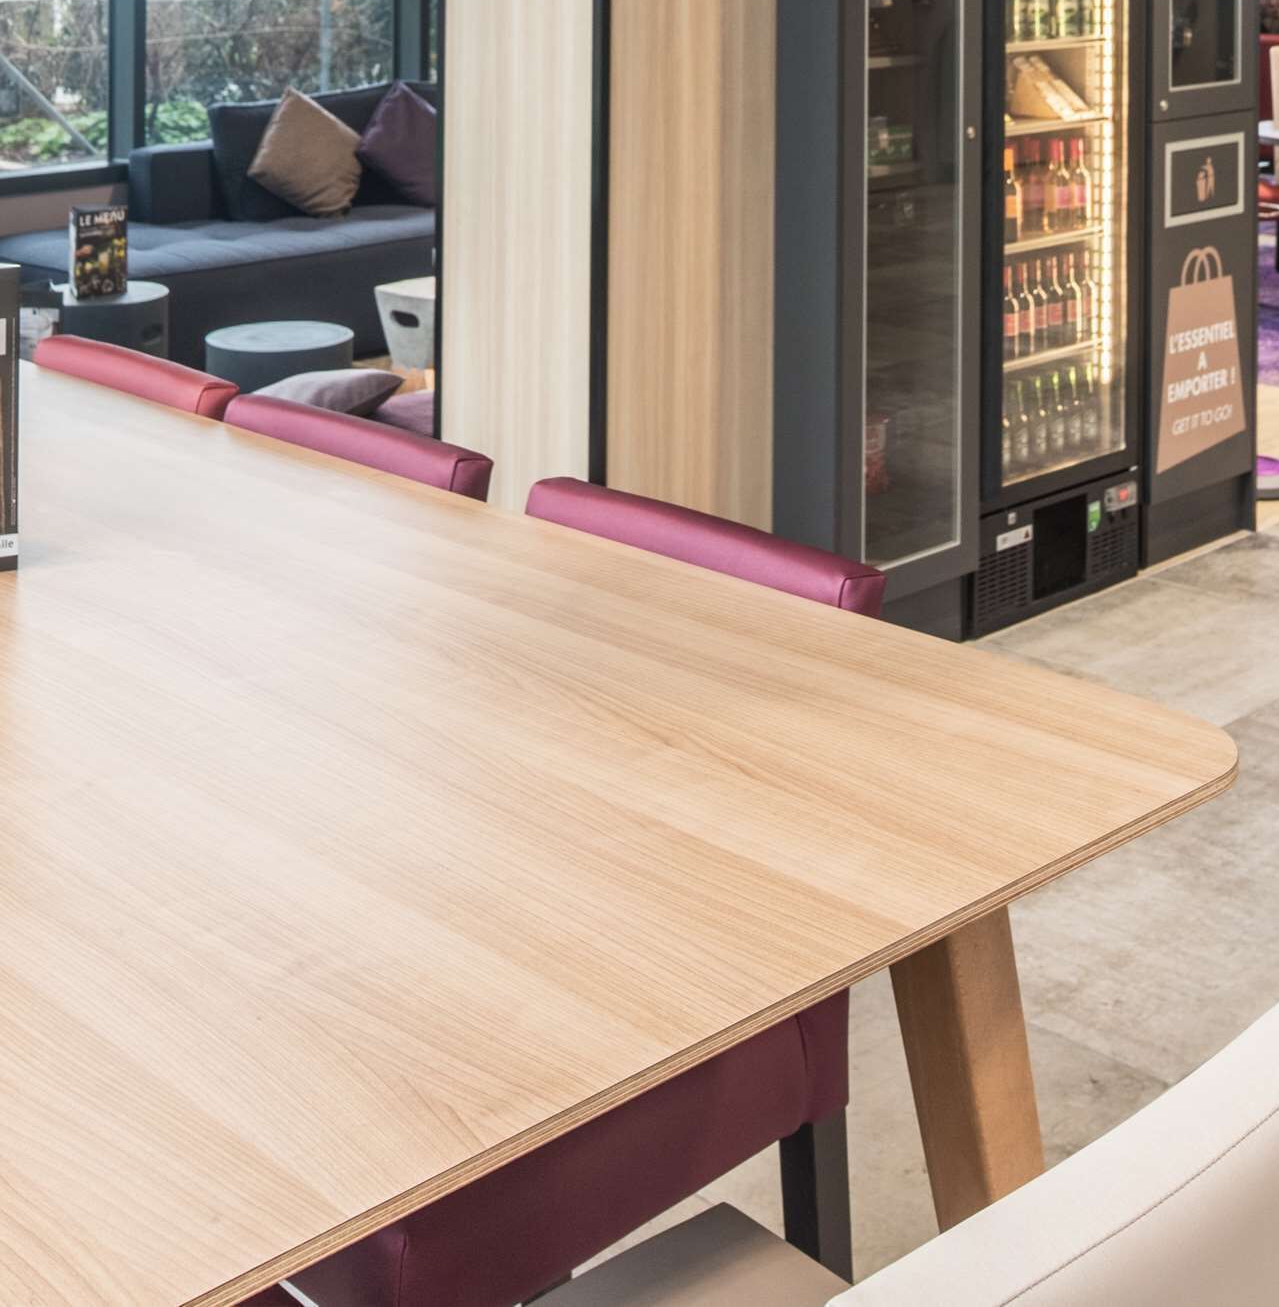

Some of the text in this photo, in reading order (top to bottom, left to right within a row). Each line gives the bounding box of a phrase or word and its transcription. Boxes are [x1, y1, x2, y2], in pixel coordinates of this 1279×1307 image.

[79, 214, 92, 227] LE
[1196, 351, 1208, 371] A
[1167, 368, 1228, 404] EMPORTER
